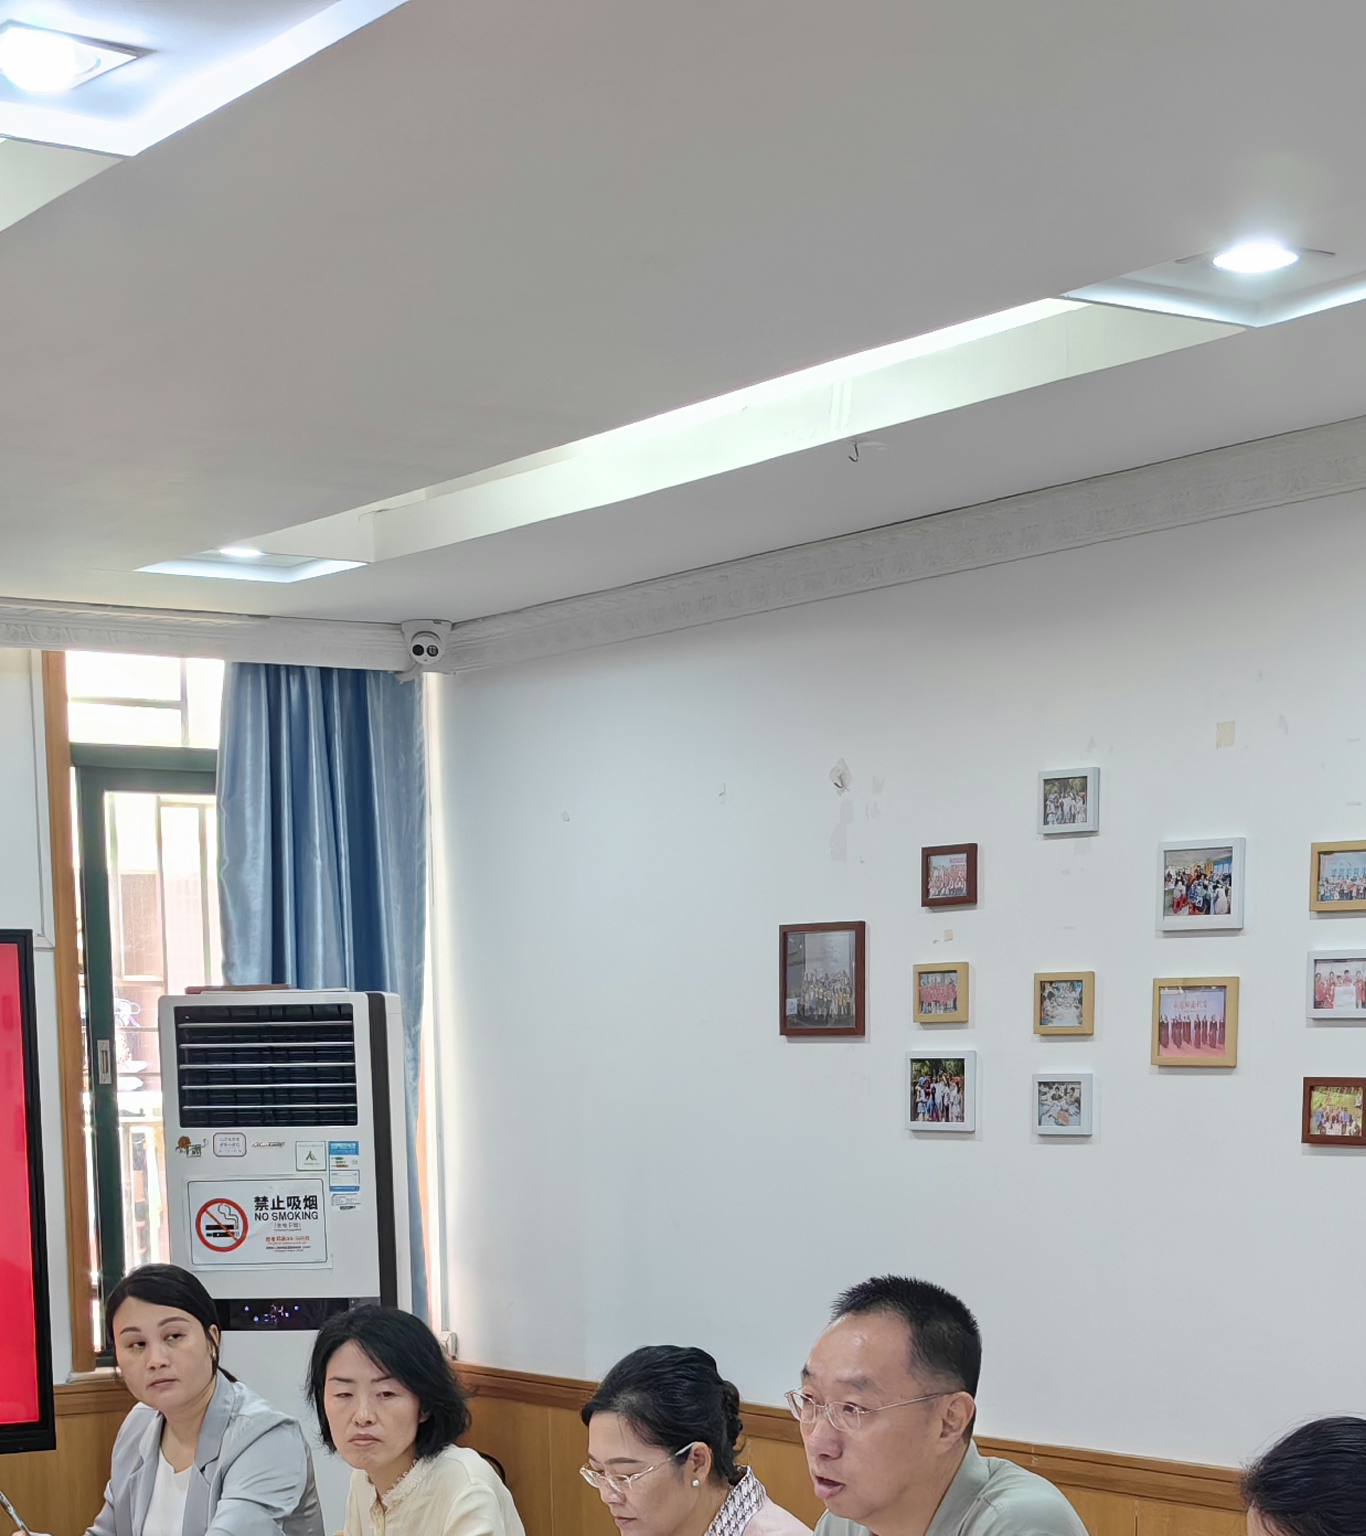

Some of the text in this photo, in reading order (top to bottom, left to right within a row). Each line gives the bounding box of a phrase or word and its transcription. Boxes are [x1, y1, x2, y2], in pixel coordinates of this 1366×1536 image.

[254, 1195, 318, 1211] 禁止吸烟
[254, 1210, 319, 1221] NO SMOKING
